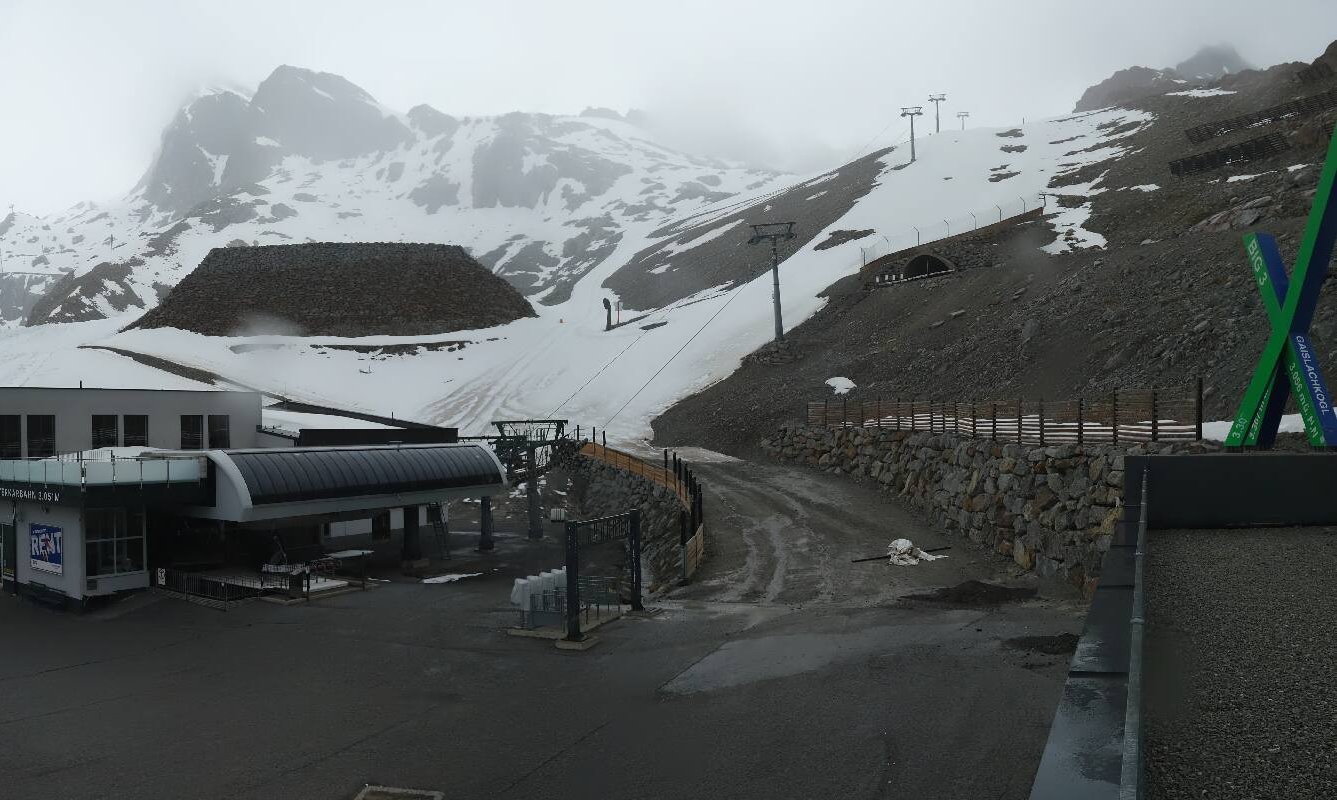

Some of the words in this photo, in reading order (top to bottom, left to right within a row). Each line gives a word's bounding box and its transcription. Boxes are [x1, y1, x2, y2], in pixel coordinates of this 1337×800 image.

[1247, 239, 1263, 273] BIG
[1258, 273, 1268, 286] 3
[1296, 335, 1330, 416] GAISLACHKOGL
[30, 532, 62, 556] RENT
